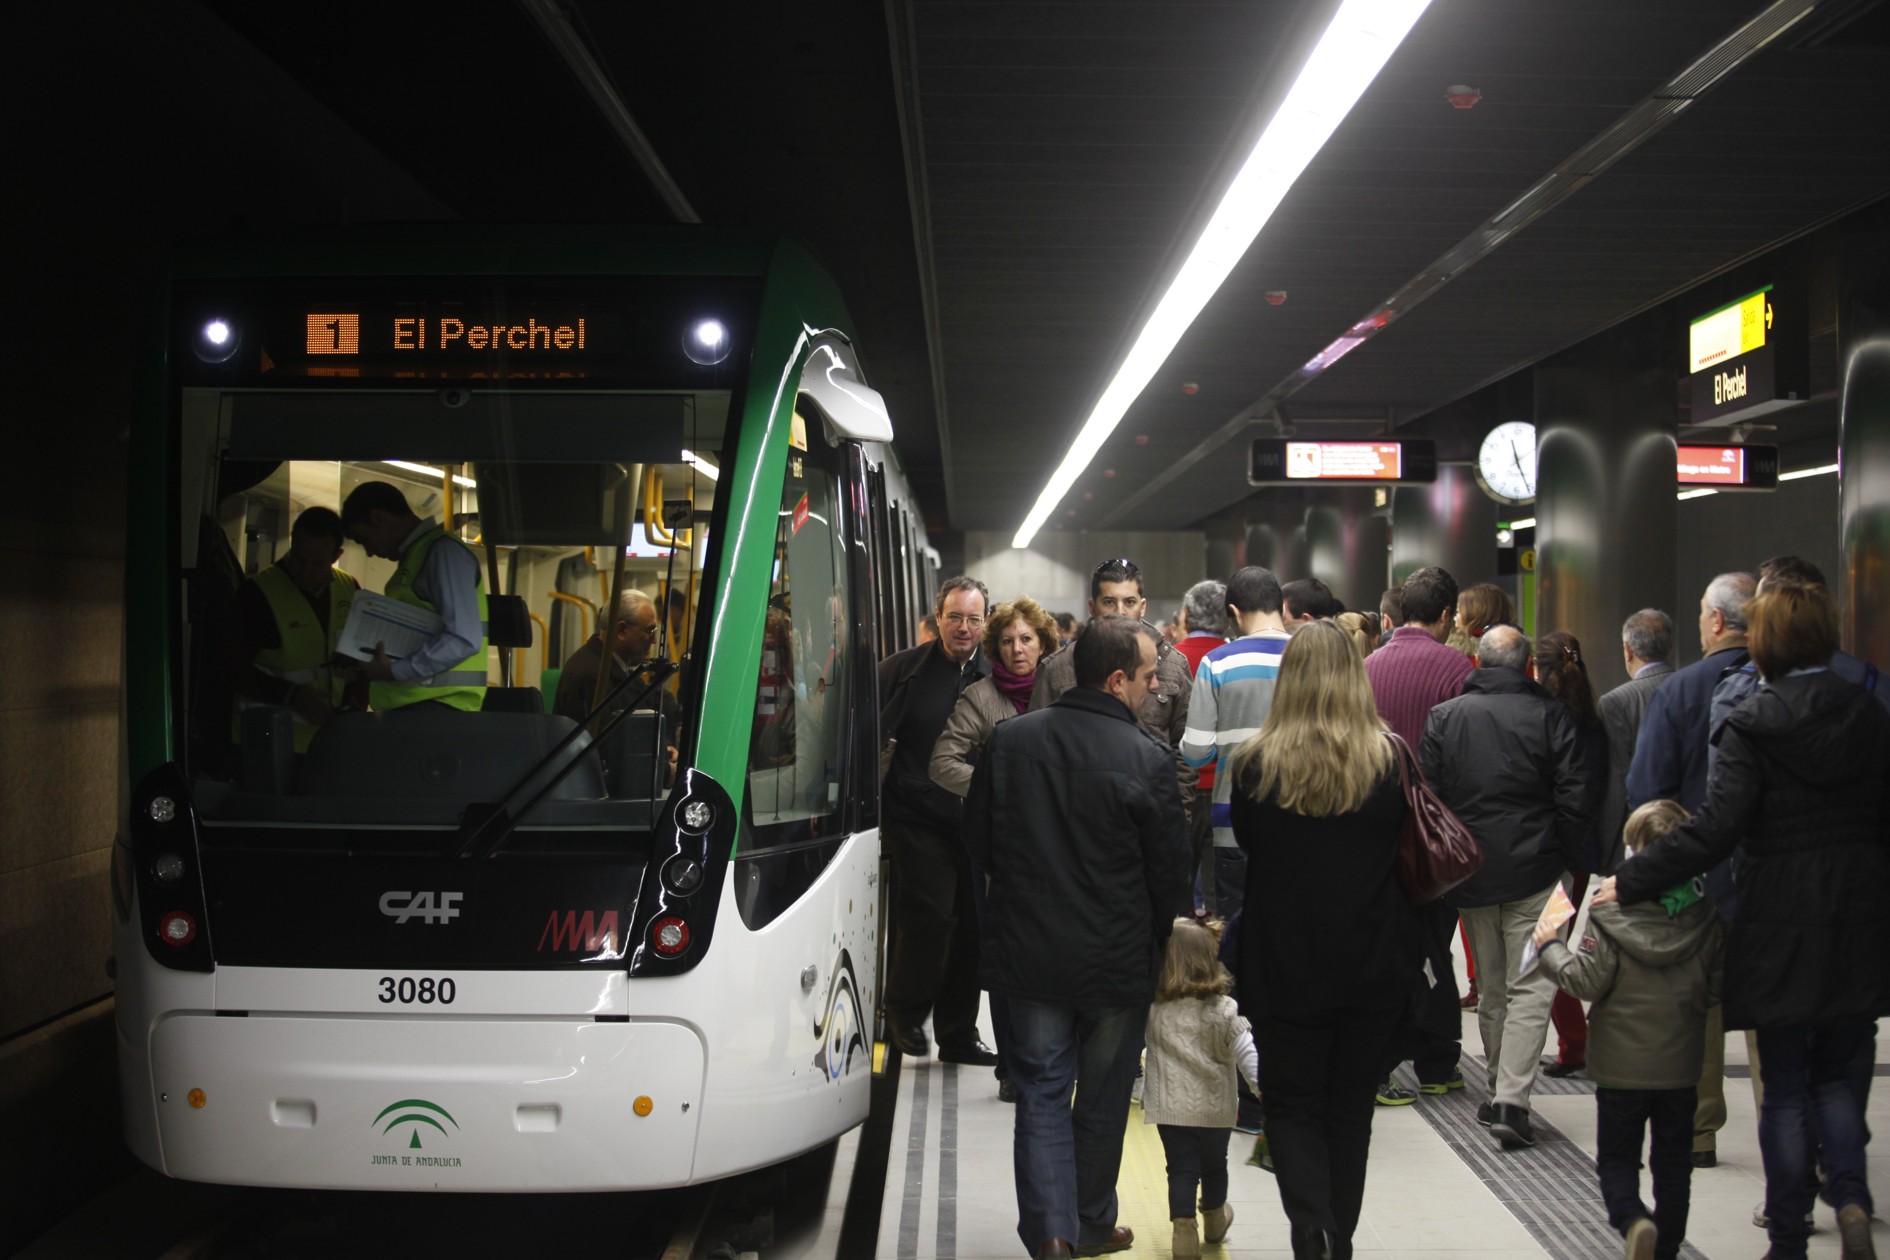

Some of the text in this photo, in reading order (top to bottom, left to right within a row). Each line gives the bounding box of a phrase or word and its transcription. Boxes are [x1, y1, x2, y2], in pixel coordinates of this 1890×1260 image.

[394, 318, 425, 349] El
[441, 318, 585, 349] Perchel
[1714, 365, 1747, 405] El Perchel
[378, 890, 464, 925] CAF
[378, 976, 456, 1005] 3080
[371, 1155, 462, 1167] JUNTA DE ANDALUCIA
